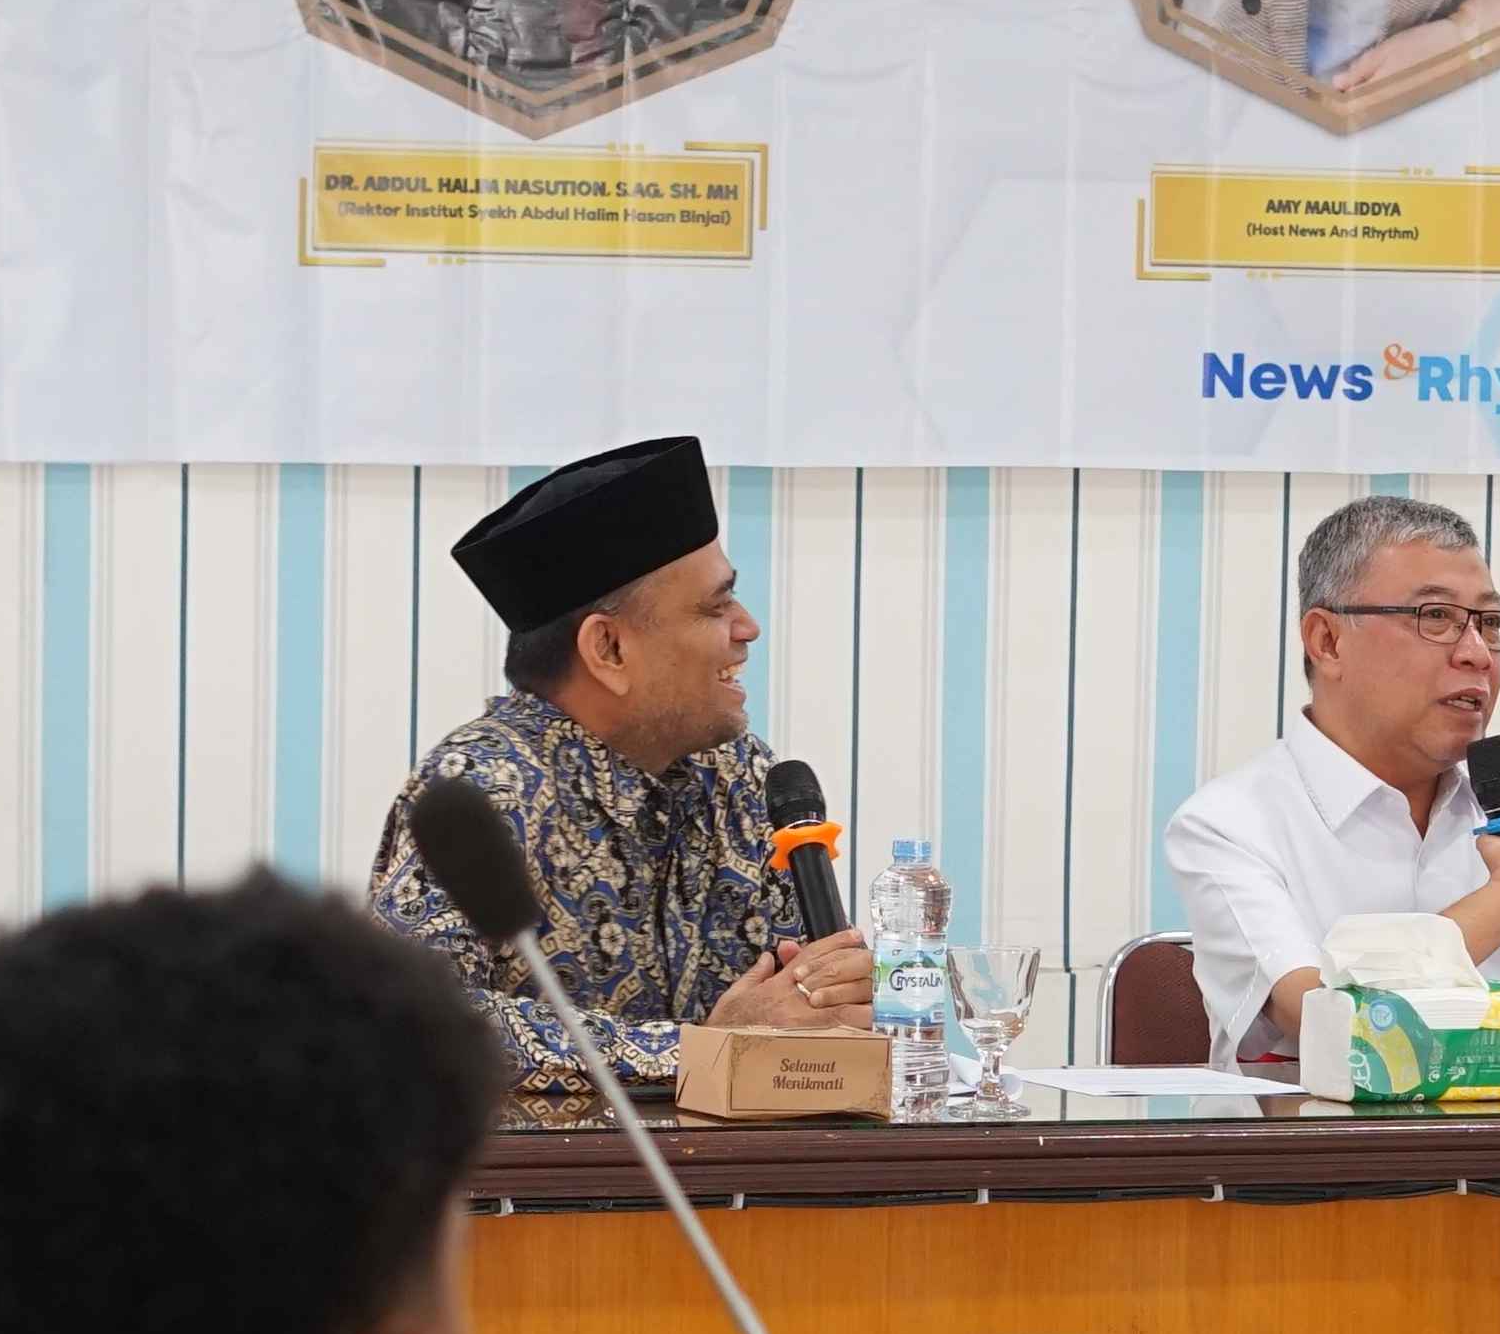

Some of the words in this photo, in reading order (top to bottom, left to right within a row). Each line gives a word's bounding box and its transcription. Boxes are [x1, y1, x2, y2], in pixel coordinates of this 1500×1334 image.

[325, 175, 358, 191] DR.
[363, 175, 432, 193] ABDUL
[437, 177, 499, 195] HALIM
[706, 184, 739, 201] MH
[339, 201, 401, 218] (Rektor
[406, 204, 463, 219] Institut
[468, 204, 517, 222] Syekh
[521, 206, 570, 221] Abdul
[573, 208, 619, 223] Halim
[623, 208, 676, 224] Hasan
[679, 210, 732, 227] Binjai)
[1265, 199, 1301, 214] AMY
[1305, 200, 1401, 217] MAULIDDYA
[1246, 222, 1285, 237] (Host
[1290, 224, 1326, 238] News
[1330, 226, 1358, 239] And
[1362, 226, 1419, 243] Rhythm)
[1202, 352, 1374, 402] News
[1383, 343, 1416, 381] &
[780, 1058, 836, 1074] Selamat
[772, 1075, 844, 1091] Menikmati
